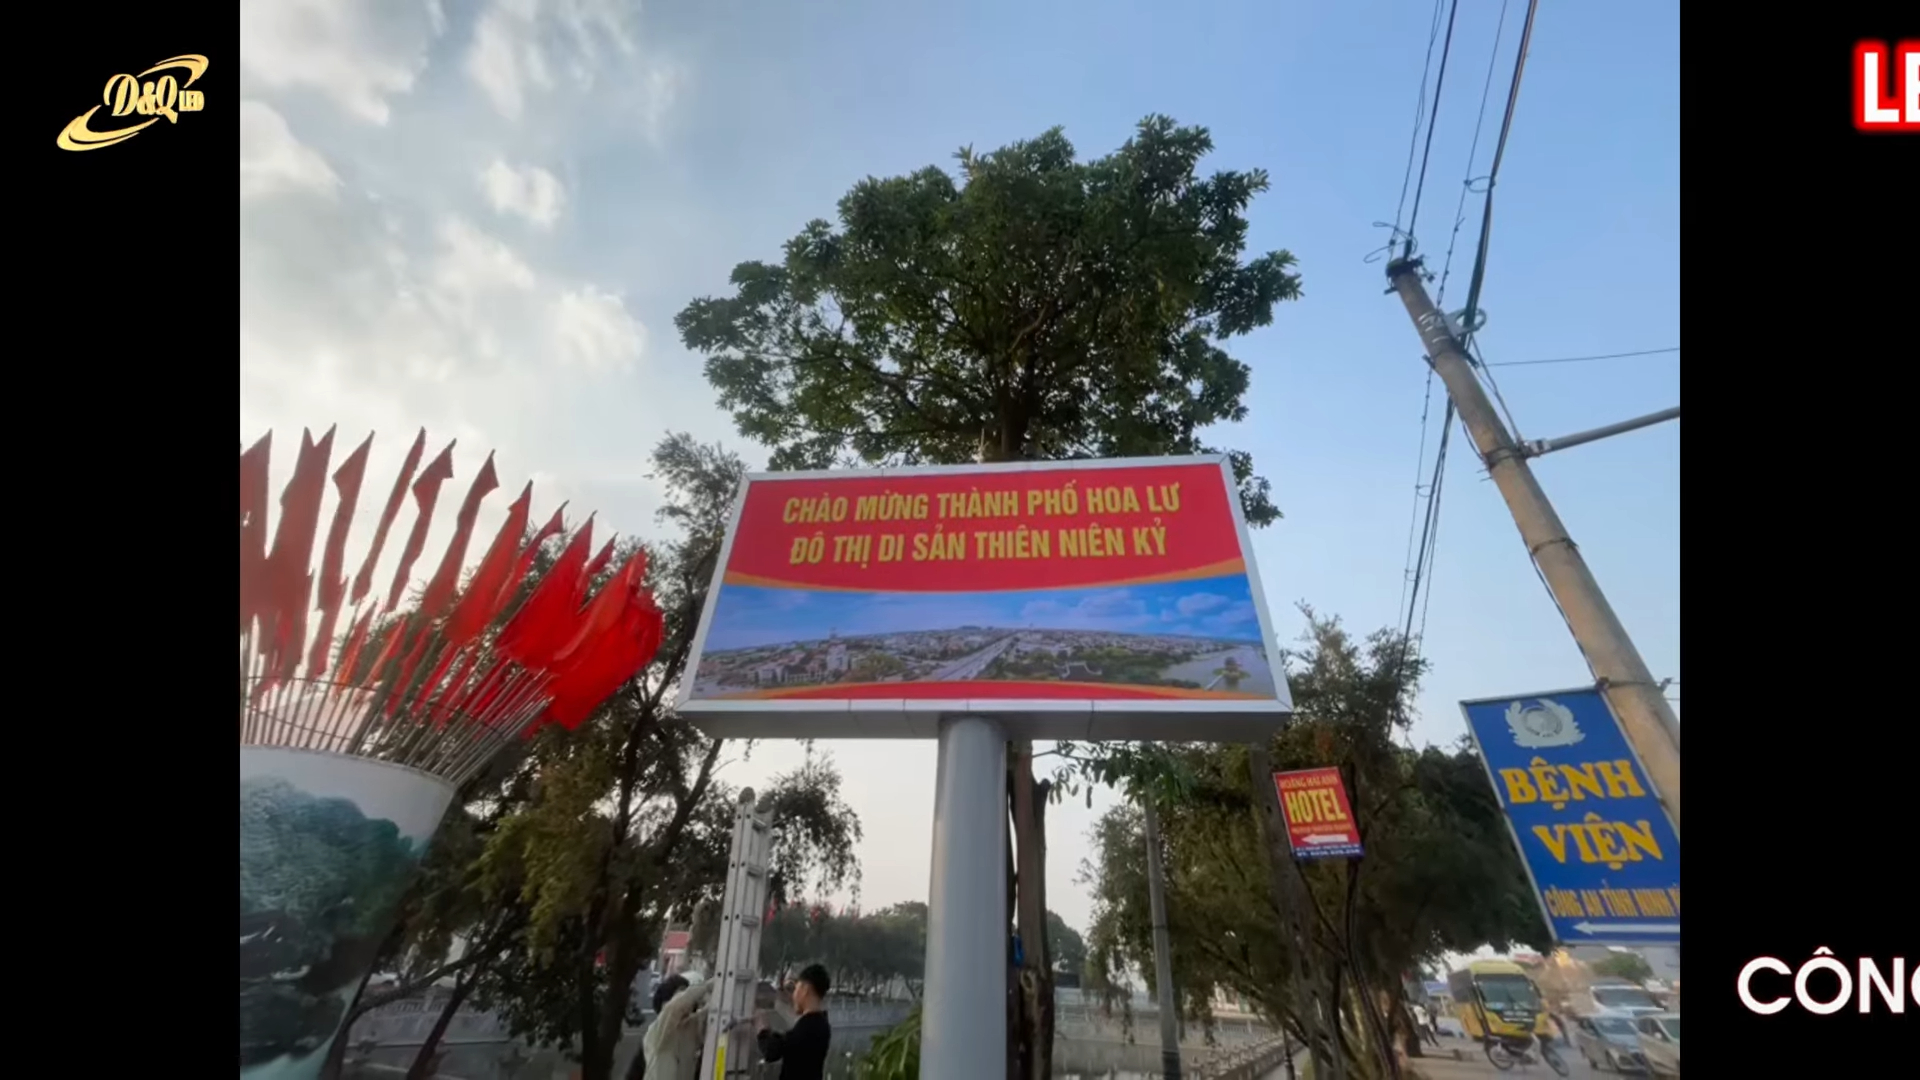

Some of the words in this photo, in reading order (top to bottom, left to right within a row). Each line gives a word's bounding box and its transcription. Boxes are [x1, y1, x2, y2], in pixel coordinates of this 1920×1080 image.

[783, 492, 848, 523] CHÀO
[854, 489, 929, 521] MỪNG
[937, 486, 1018, 518] THÀNH
[1027, 479, 1078, 515] PHỐ
[1086, 486, 1140, 514] HOA
[1146, 482, 1180, 513] LƯ
[789, 530, 825, 565] ĐÔ
[833, 534, 871, 569] THỊ
[878, 534, 905, 562] DI
[912, 523, 966, 561] SẢN
[974, 524, 1050, 560] THIÊN
[1059, 522, 1125, 558] NIÊN
[1132, 517, 1166, 556] KỶ
[1284, 787, 1348, 824] HOTEL
[1499, 756, 1646, 810] BỆNH
[1532, 812, 1663, 870] VIỆN
